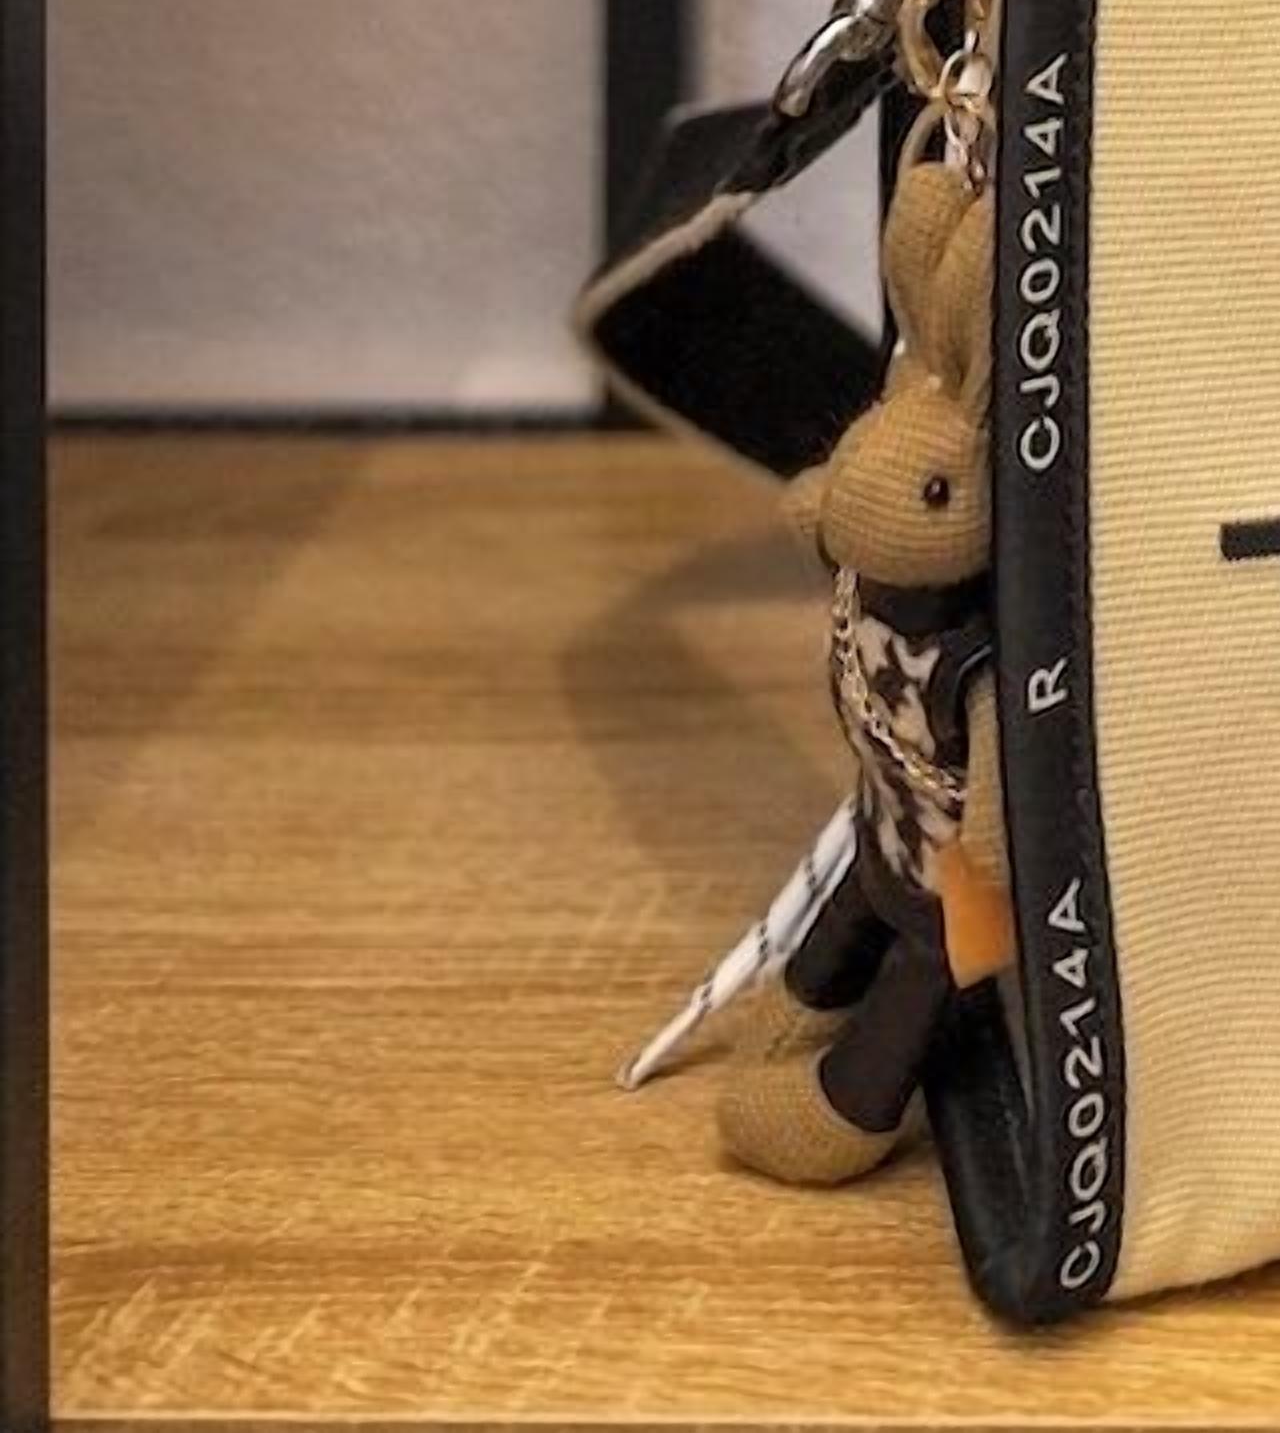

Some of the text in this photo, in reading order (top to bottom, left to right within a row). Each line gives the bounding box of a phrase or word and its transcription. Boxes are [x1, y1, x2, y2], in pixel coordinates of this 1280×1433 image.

[1019, 53, 1067, 471] CJQ0214A
[1027, 658, 1068, 713] R
[1047, 879, 1107, 1288] CJQ0214A
